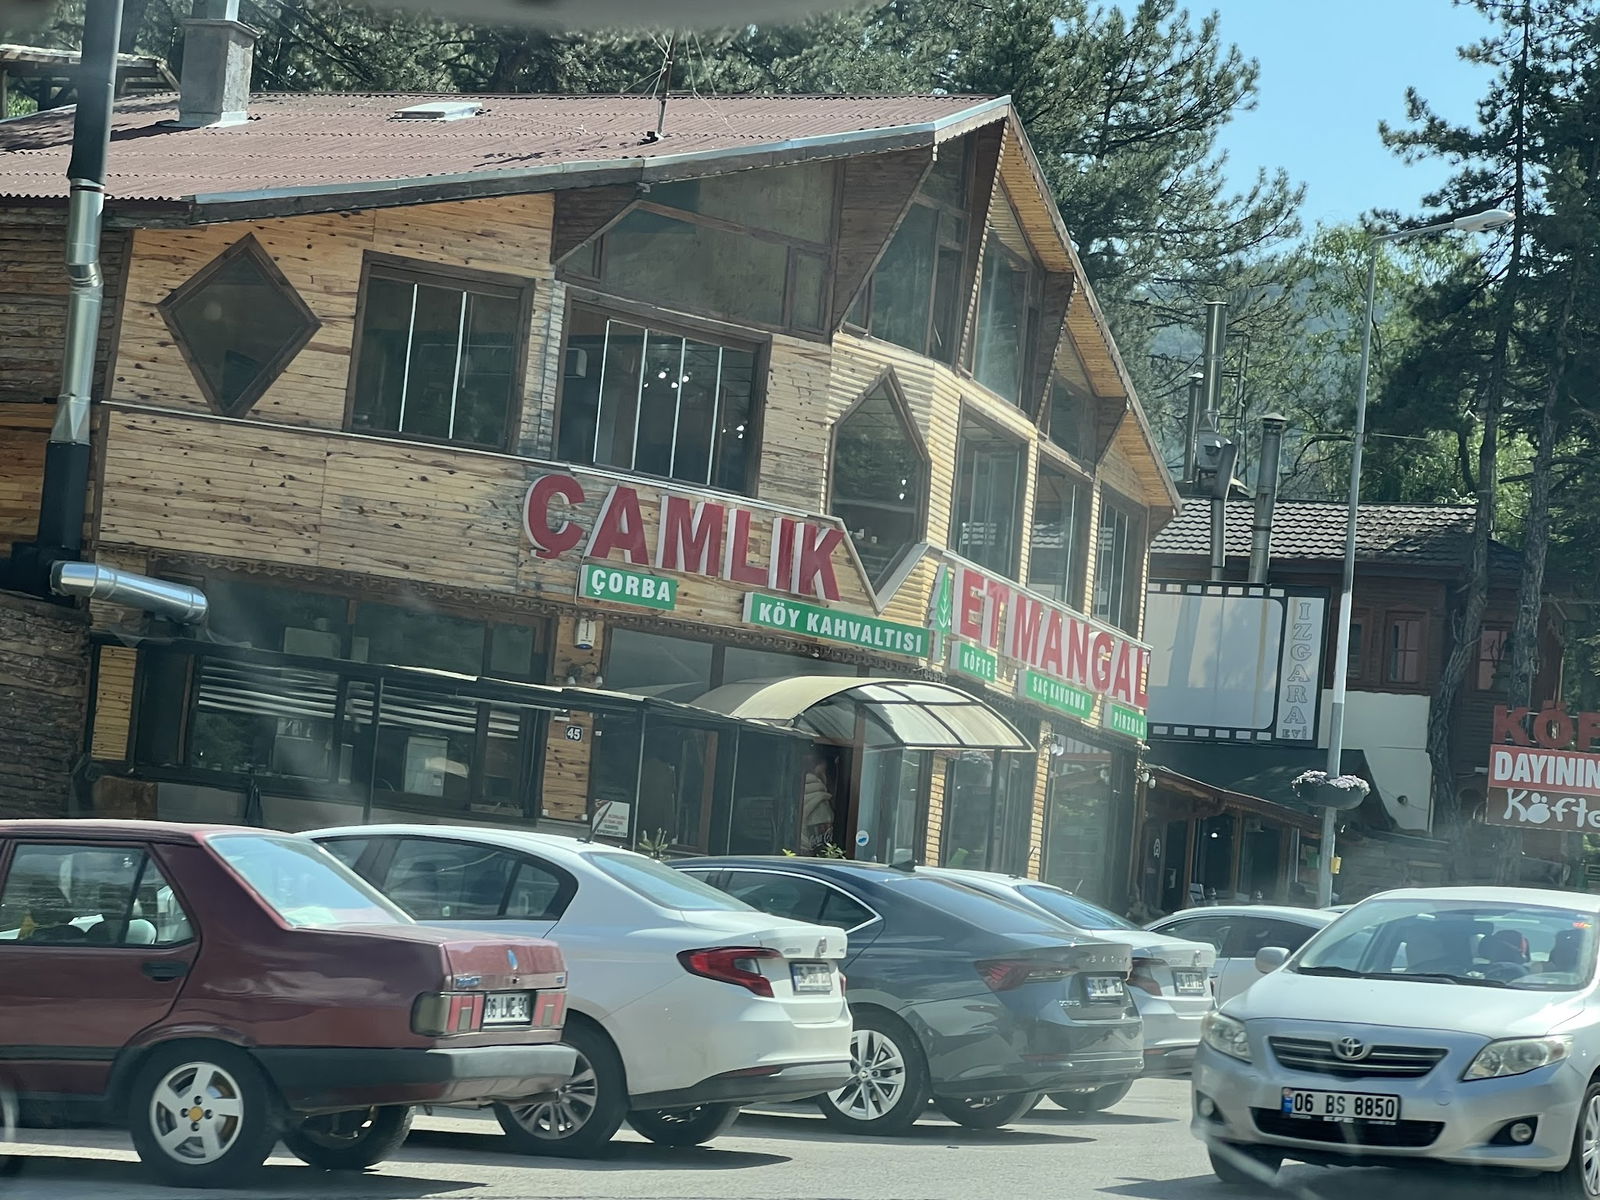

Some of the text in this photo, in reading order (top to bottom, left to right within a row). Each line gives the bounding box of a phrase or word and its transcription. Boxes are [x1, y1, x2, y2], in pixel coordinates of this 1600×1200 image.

[523, 474, 845, 602] ÇAMLIK
[591, 569, 671, 603] ÇORBA
[758, 602, 922, 653] KÖY KAHVALTISI
[952, 566, 1149, 709] ET MANGAL
[963, 650, 992, 678] KÖFTE
[1032, 676, 1086, 711] SAÇ KAVURMA
[567, 727, 581, 740] 45
[1113, 710, 1145, 736] PİRZOLA
[1494, 751, 1600, 789] DAYININ
[1294, 1092, 1395, 1118] 06 BS 8850
